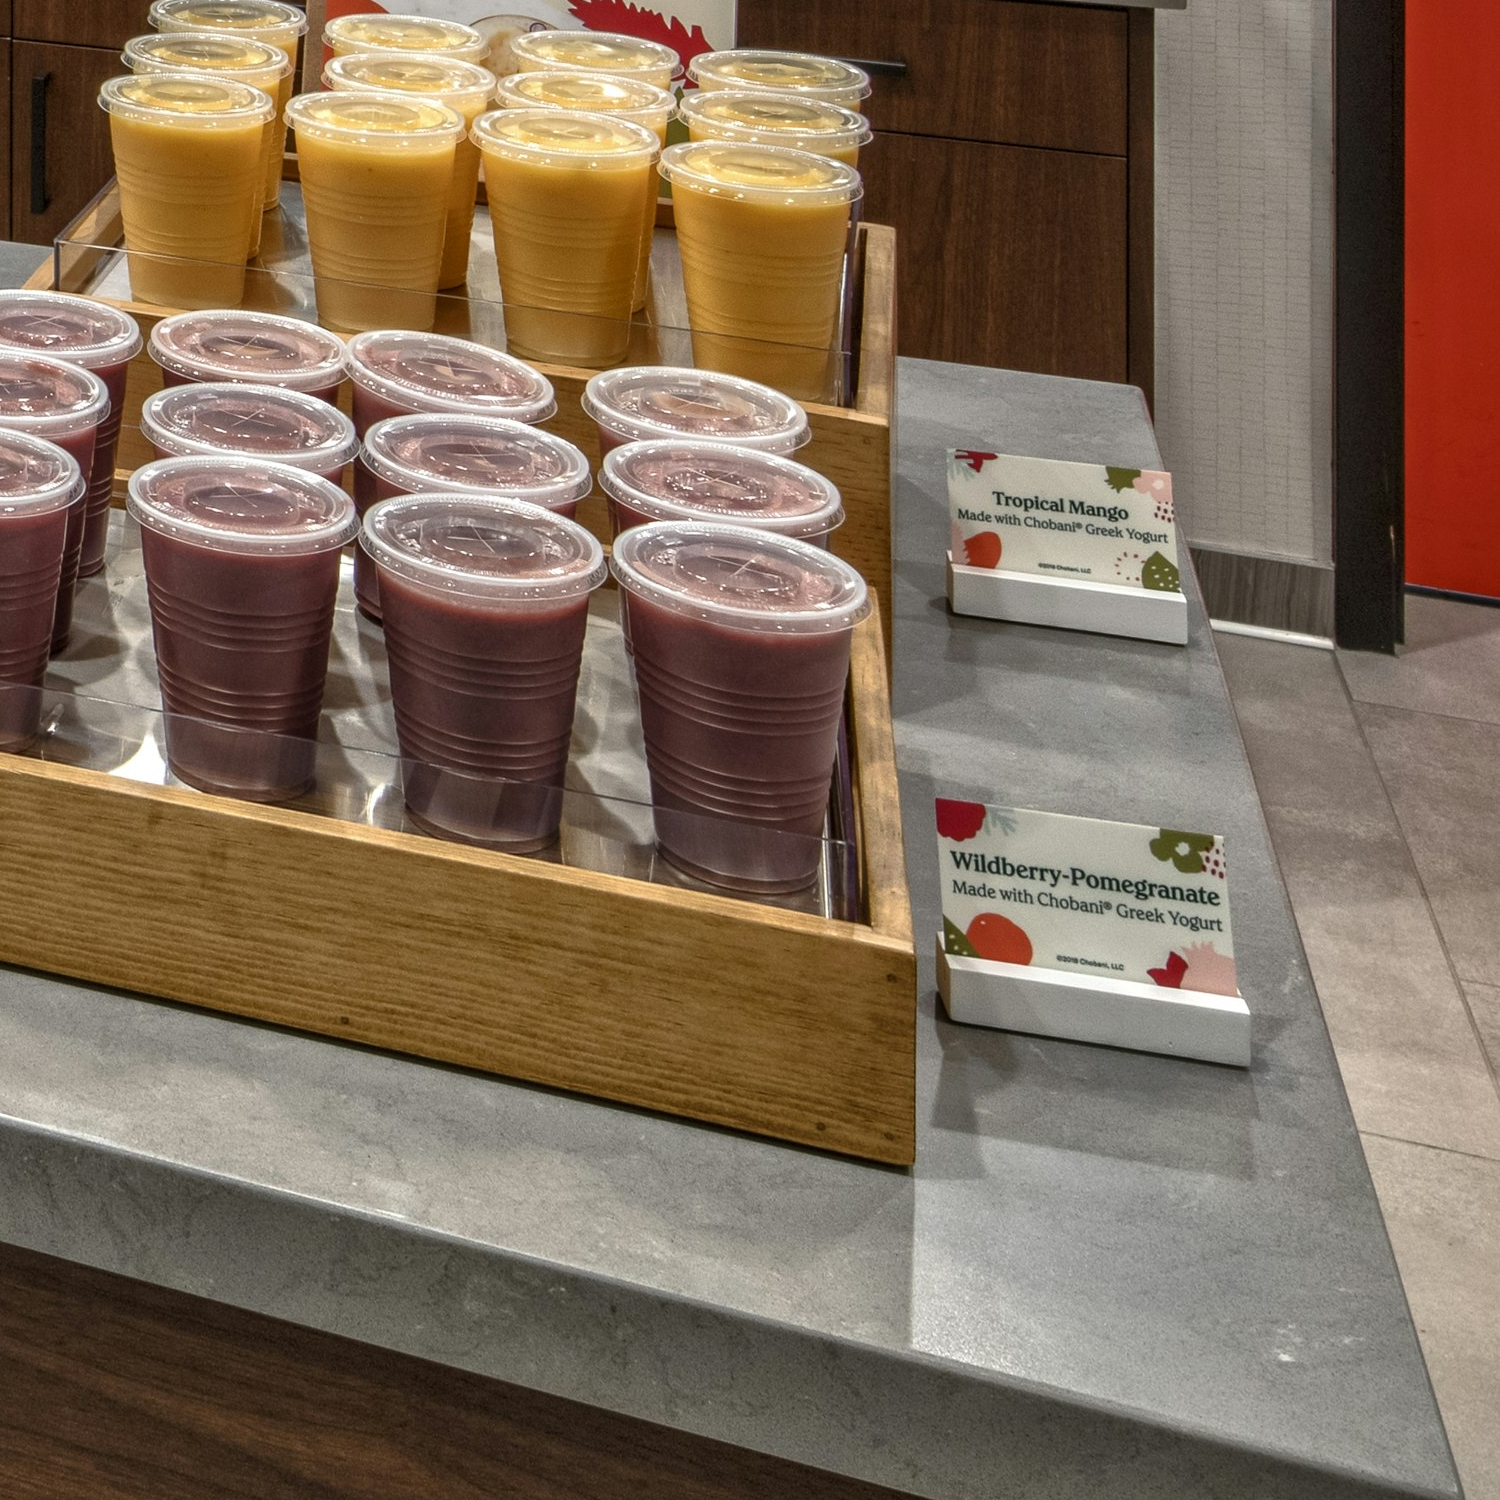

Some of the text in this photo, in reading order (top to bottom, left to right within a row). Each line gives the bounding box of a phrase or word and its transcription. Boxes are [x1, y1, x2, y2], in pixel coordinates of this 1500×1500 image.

[992, 491, 1129, 522] Tropical Mango
[957, 508, 1169, 544] Made with Chobani® Greek Yogurt
[950, 850, 1221, 907] Wildberry-Pomegranate
[952, 879, 1224, 932] Made with Chobani® Greek Yogurt
[1079, 957, 1110, 970] Chobani,
[1111, 963, 1125, 971] LLC
